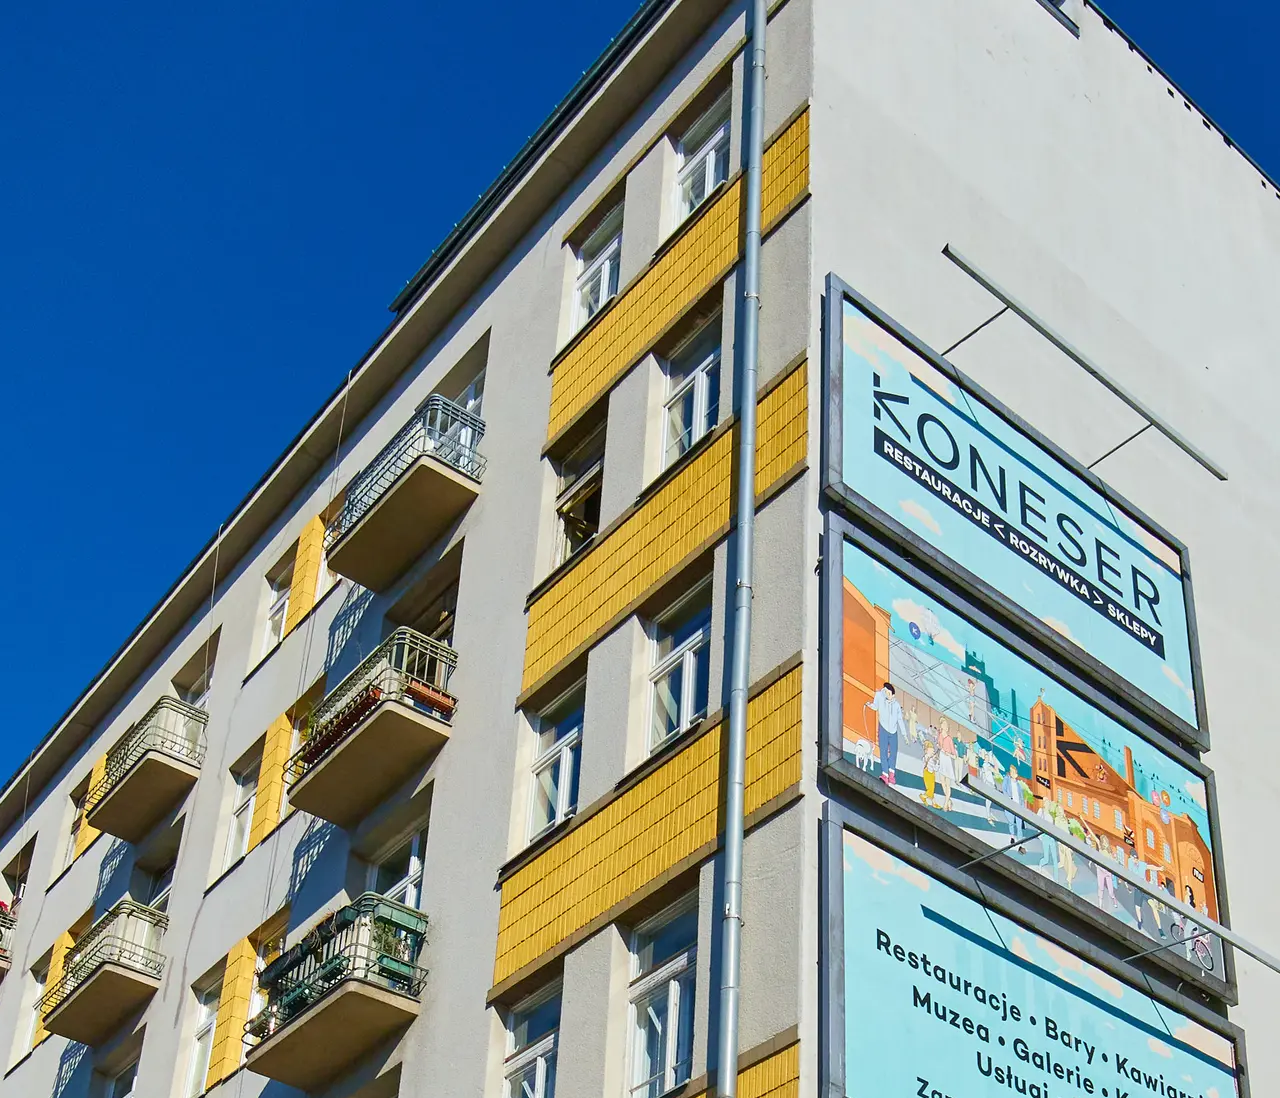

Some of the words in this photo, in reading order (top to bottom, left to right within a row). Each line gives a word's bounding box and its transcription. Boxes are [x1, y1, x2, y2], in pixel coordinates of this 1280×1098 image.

[873, 371, 1163, 627] KONESER
[883, 440, 991, 529] RESTAURACJE
[1009, 532, 1090, 599] ROZRYWKA
[1107, 603, 1157, 646] SKLEPY
[875, 929, 1021, 1024] Restauracje
[1045, 1016, 1095, 1065] Bary
[913, 985, 990, 1045] Muzea
[1013, 1038, 1095, 1096] Galerie
